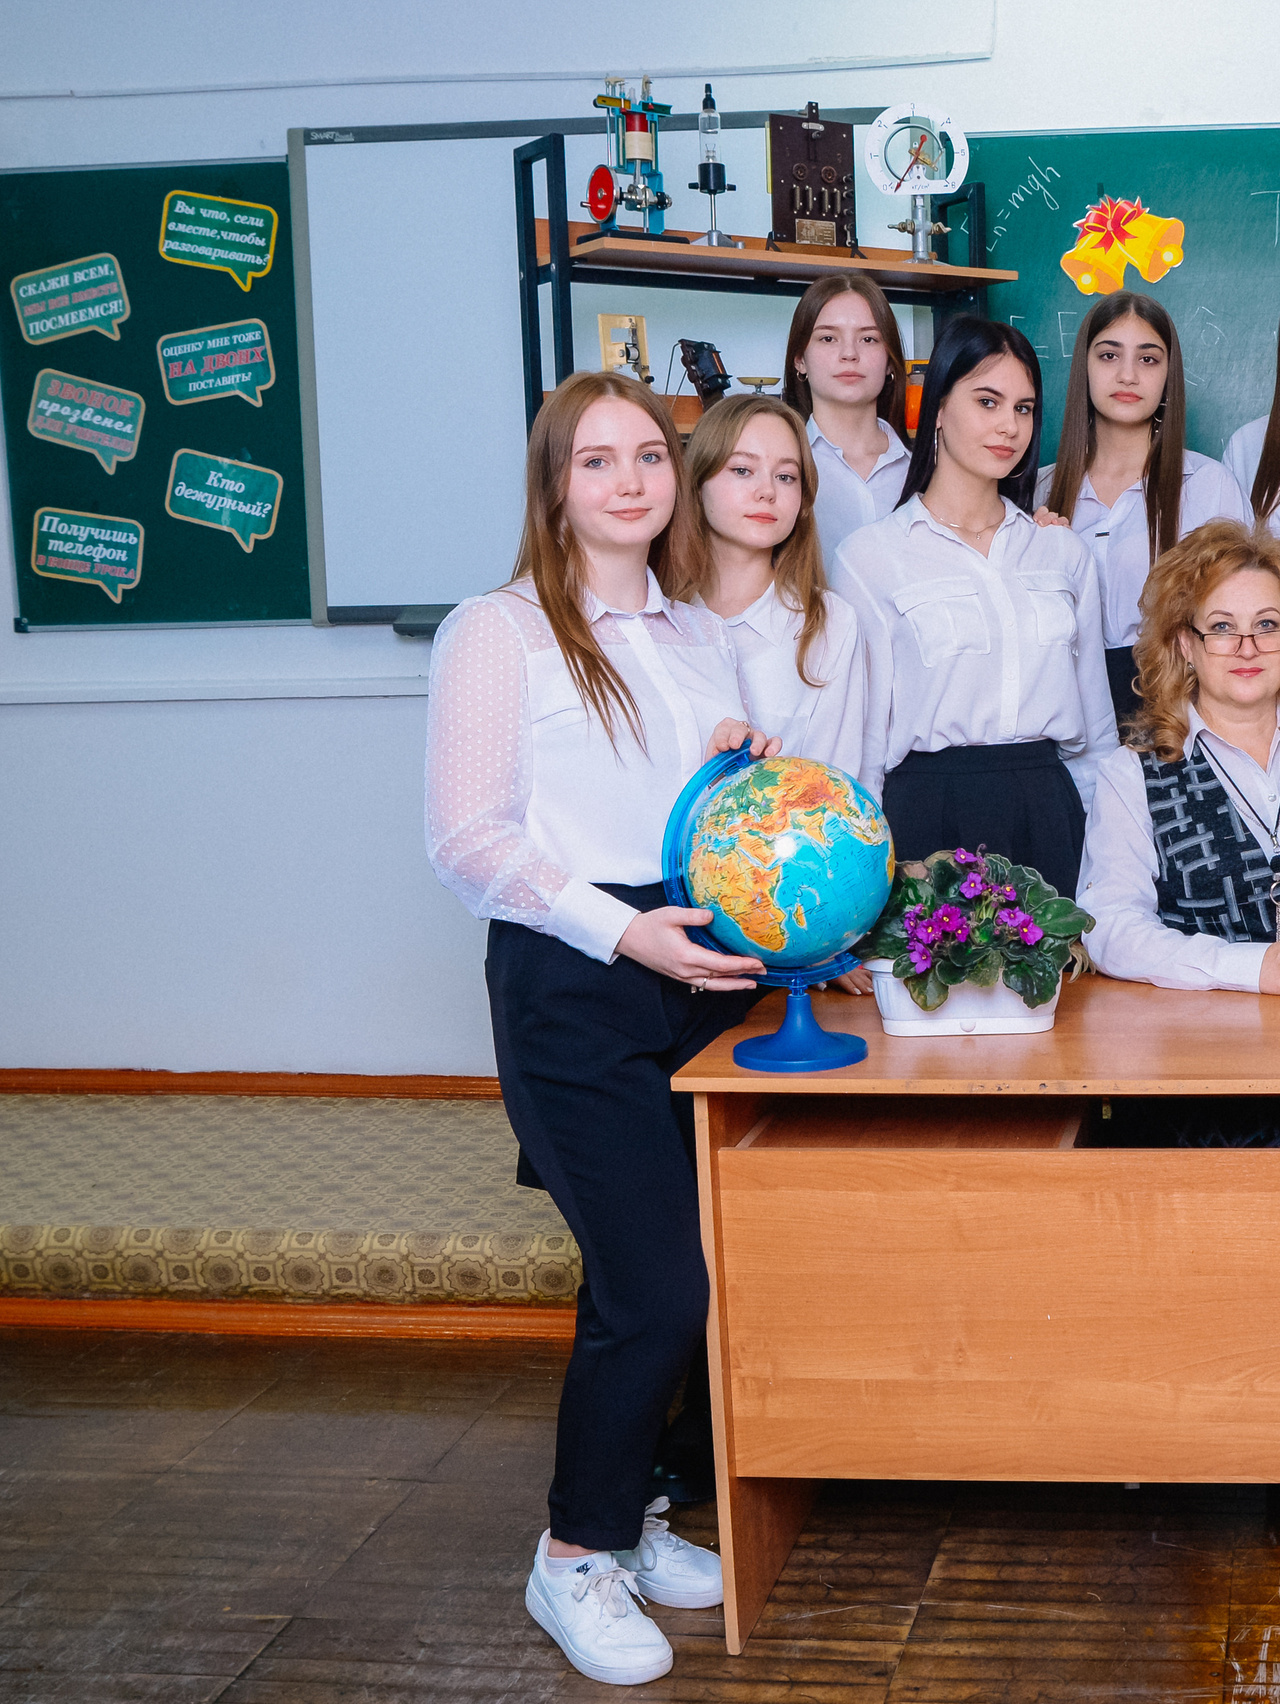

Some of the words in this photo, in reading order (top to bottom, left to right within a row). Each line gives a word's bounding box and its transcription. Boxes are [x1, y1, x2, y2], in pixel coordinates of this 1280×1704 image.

[174, 200, 195, 215] Вы
[200, 208, 231, 223] что,
[233, 214, 264, 227] сели
[162, 239, 270, 266] разговаривать?
[19, 274, 70, 298] СКАЖИ
[73, 264, 114, 284] ВСЕМ,
[28, 299, 123, 336] ПОСМЕЕМСЯ!
[163, 341, 204, 357] ОЦЕНКУ
[207, 336, 230, 349] МНЕ
[232, 330, 262, 344] ТОЖЕ
[168, 359, 197, 379] НА
[201, 345, 266, 376] ДВОИХ
[189, 372, 252, 392] ПОСТАВИТЬ?
[47, 379, 135, 417] ЗВОНОК
[37, 399, 134, 433] прозвенел
[205, 470, 245, 494] Кто
[174, 481, 272, 518] дежурный?
[40, 515, 138, 545] Получишь
[47, 539, 128, 562] телефон
[36, 554, 46, 565] В
[93, 563, 136, 580] УРОКА
